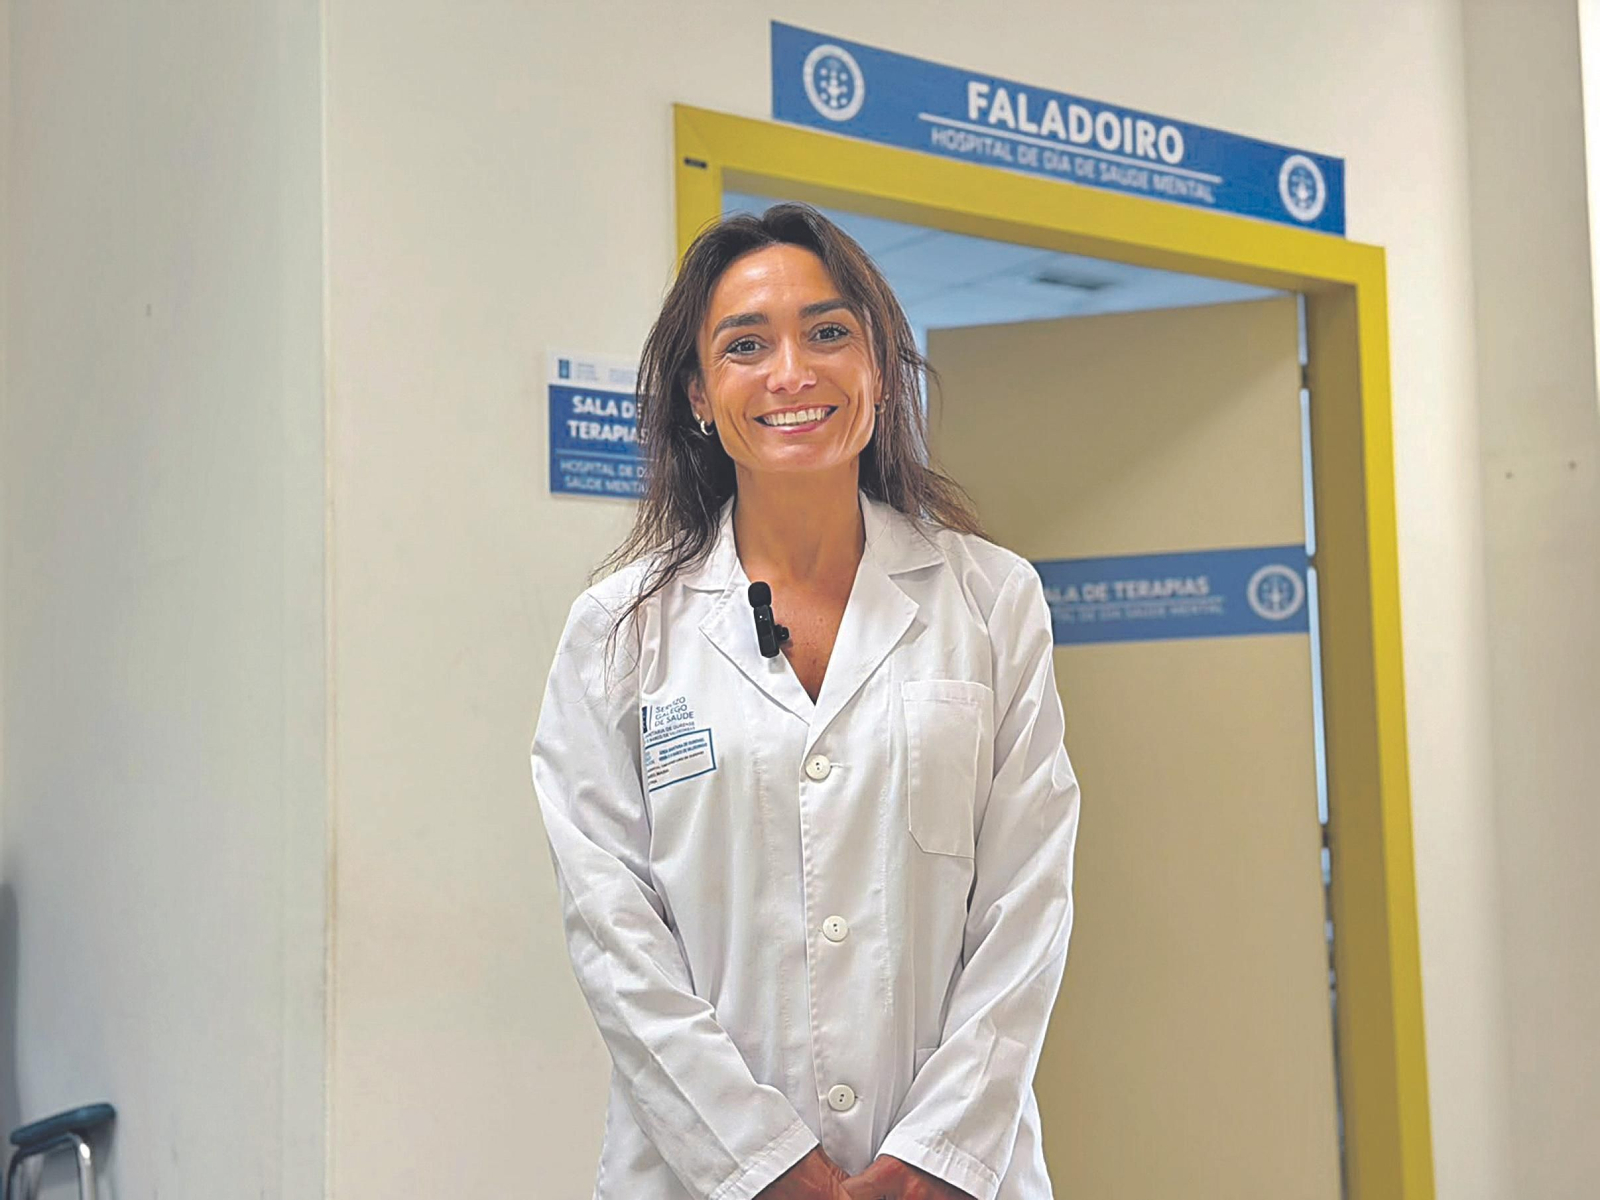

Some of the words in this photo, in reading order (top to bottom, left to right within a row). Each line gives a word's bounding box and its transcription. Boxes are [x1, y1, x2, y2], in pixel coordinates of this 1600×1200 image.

[968, 81, 1184, 164] FALADOIRO
[931, 127, 1013, 162] HOSPITAL
[1017, 144, 1039, 167] DE
[1074, 156, 1095, 178] DE
[1153, 173, 1217, 204] MENTAL
[572, 395, 618, 418] SALA
[561, 459, 615, 477] HOSPITAL
[618, 463, 633, 477] DE
[1082, 582, 1107, 602] DE
[1114, 575, 1210, 601] TERAPIAS
[655, 719, 665, 727] DE
